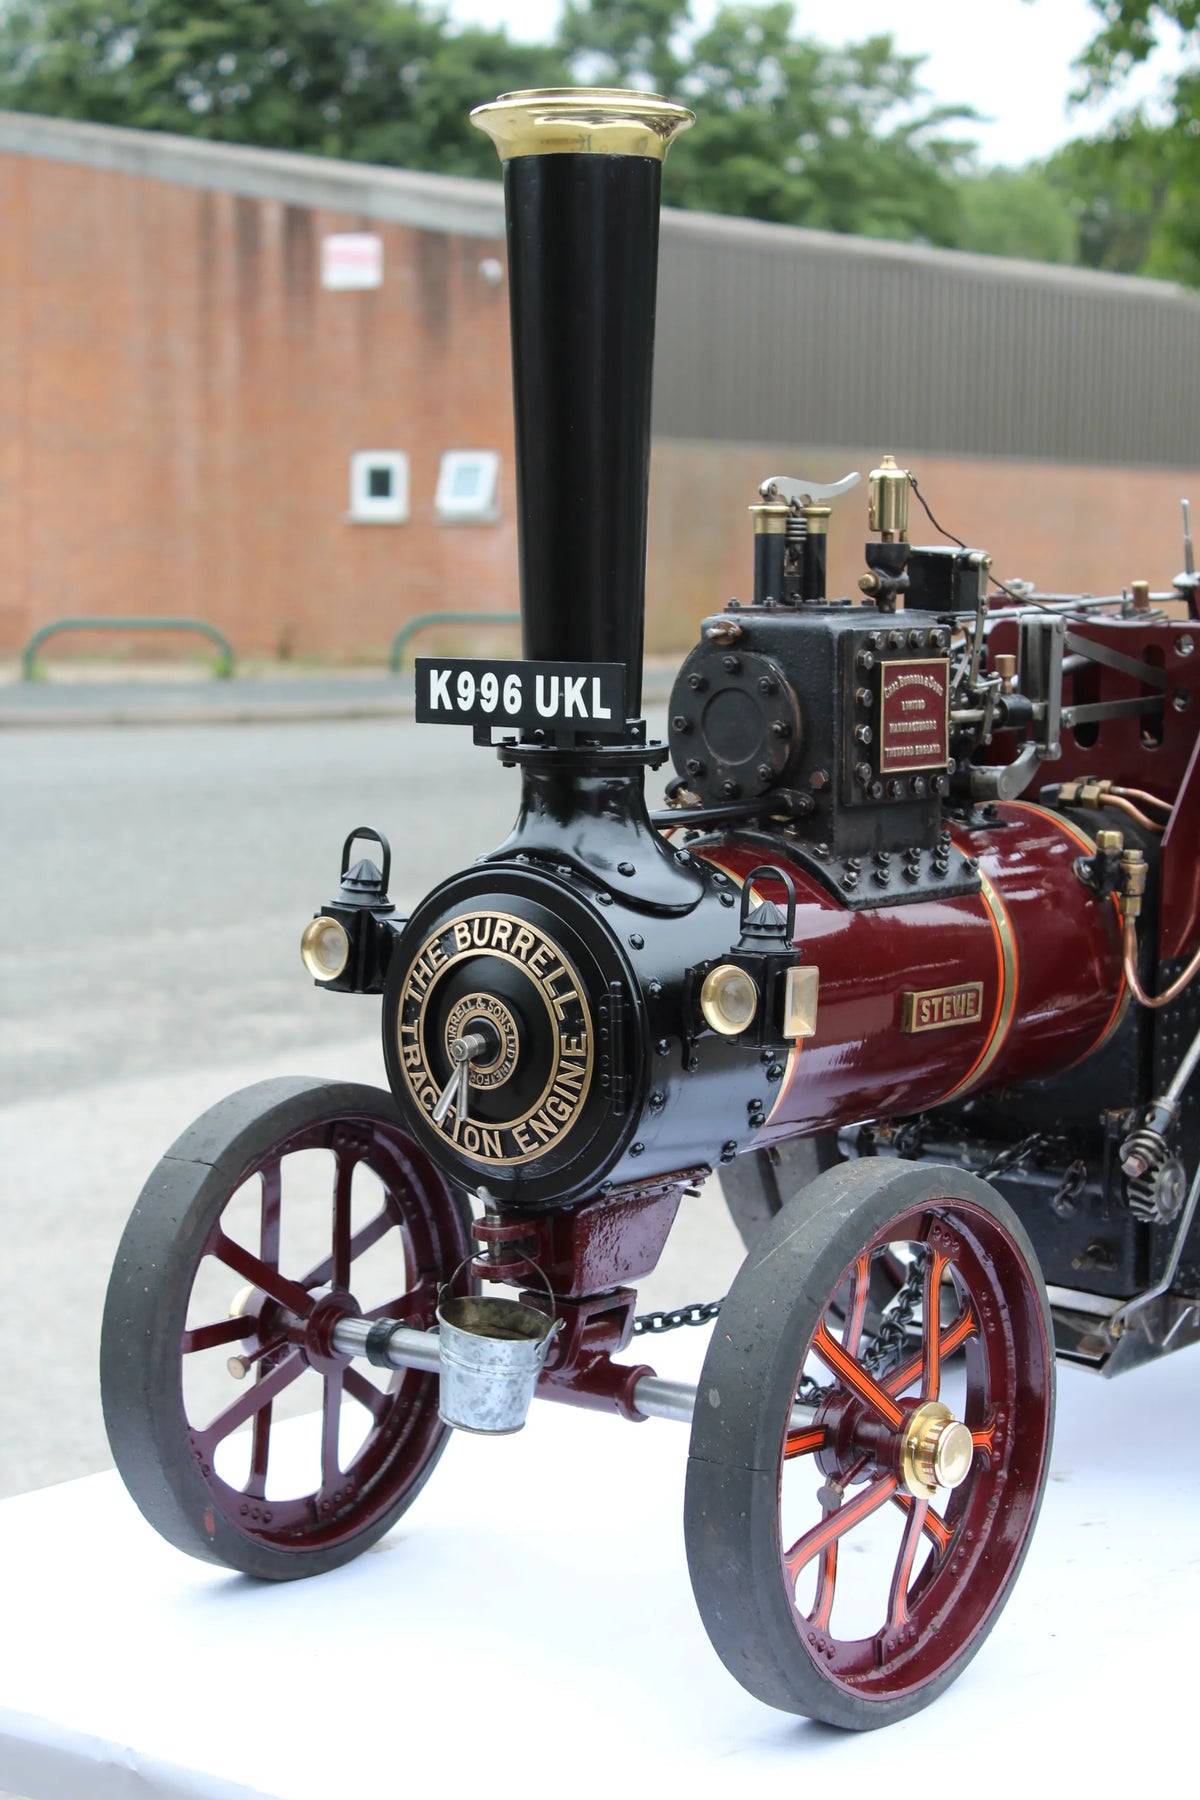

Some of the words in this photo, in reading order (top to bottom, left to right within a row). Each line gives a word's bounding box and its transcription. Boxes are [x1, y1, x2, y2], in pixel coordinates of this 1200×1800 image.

[430, 669, 522, 715] K996
[535, 674, 612, 719] UKL
[405, 939, 449, 1004] THE
[453, 918, 579, 1021] BURRELL
[448, 1000, 476, 1048] URRELL
[476, 997, 487, 1010] &
[487, 1001, 513, 1033] SONS
[921, 992, 976, 1023] STEVIE
[512, 1033, 588, 1154] ENGINE
